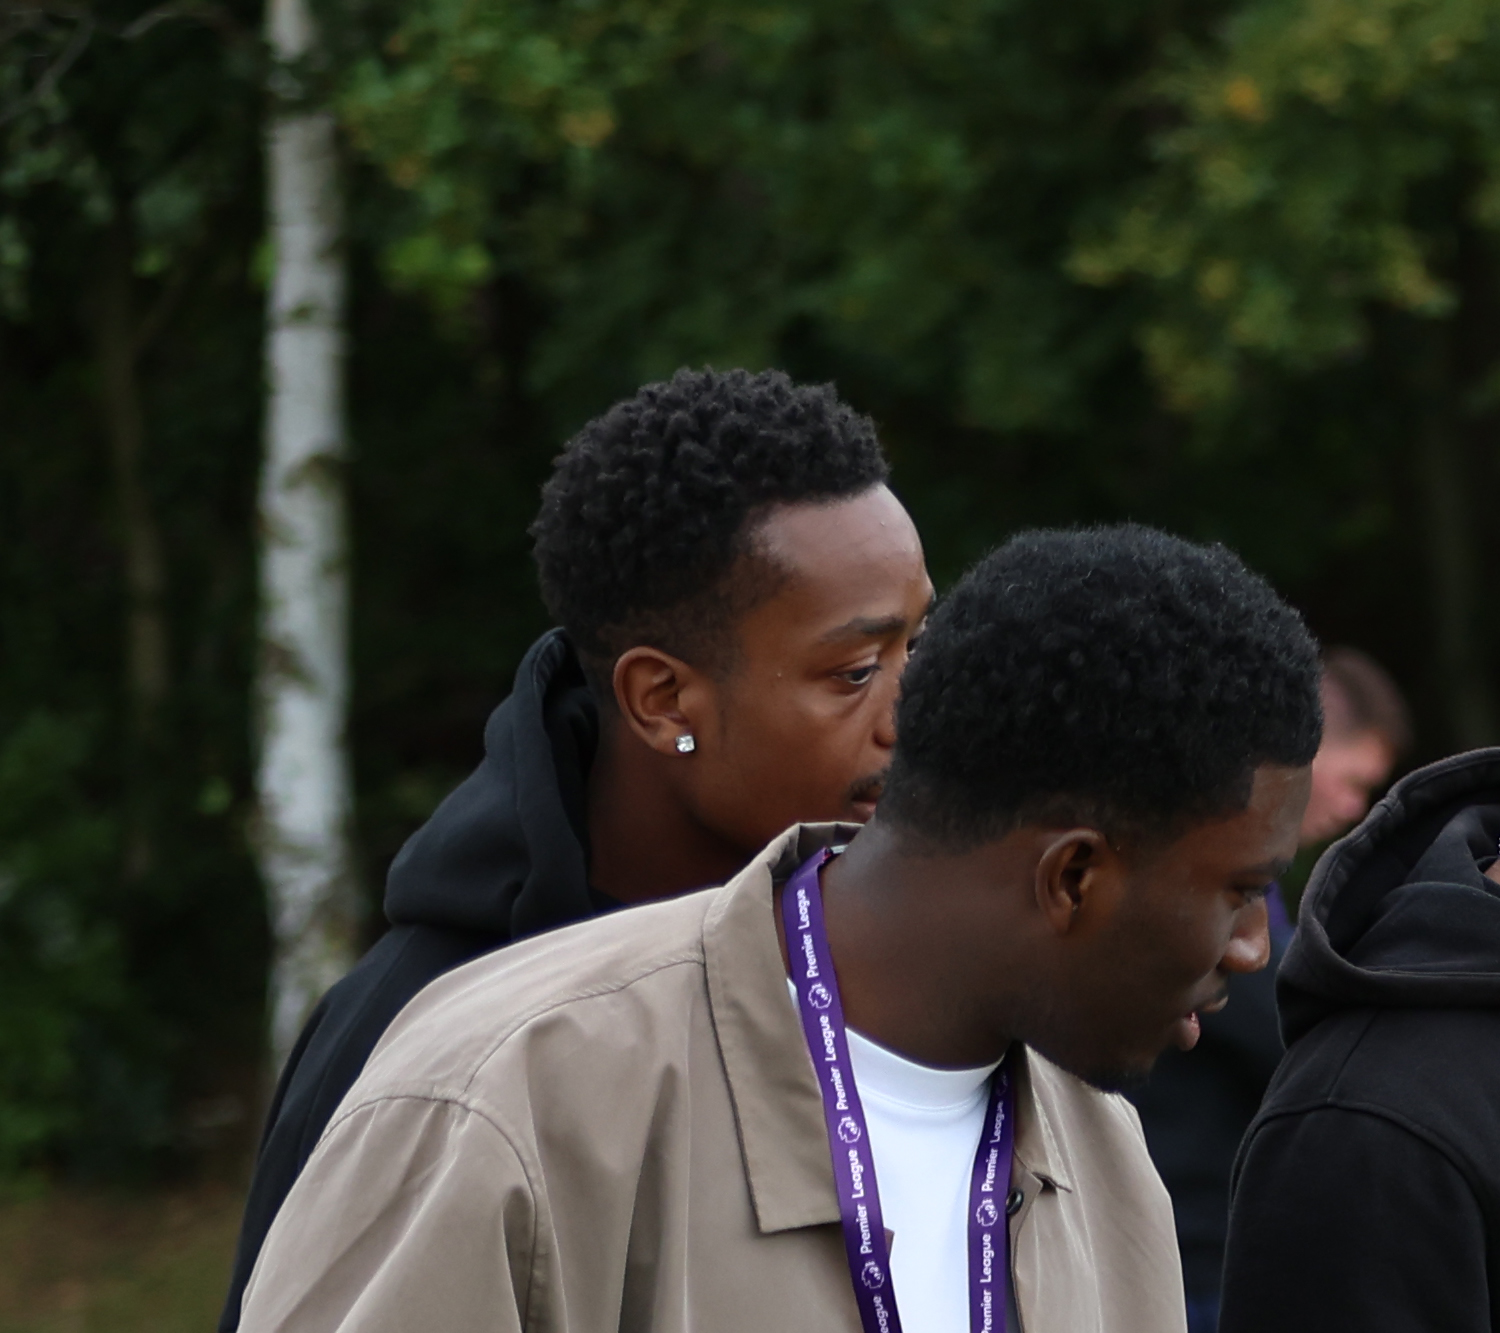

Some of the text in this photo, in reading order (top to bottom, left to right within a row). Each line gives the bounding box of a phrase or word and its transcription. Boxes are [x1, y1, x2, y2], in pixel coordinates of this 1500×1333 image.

[797, 888, 819, 978] Premier League
[819, 1014, 849, 1110] Premier League
[848, 1149, 872, 1255] Premier League
[982, 1148, 998, 1192] Premier
[980, 1233, 994, 1284] League
